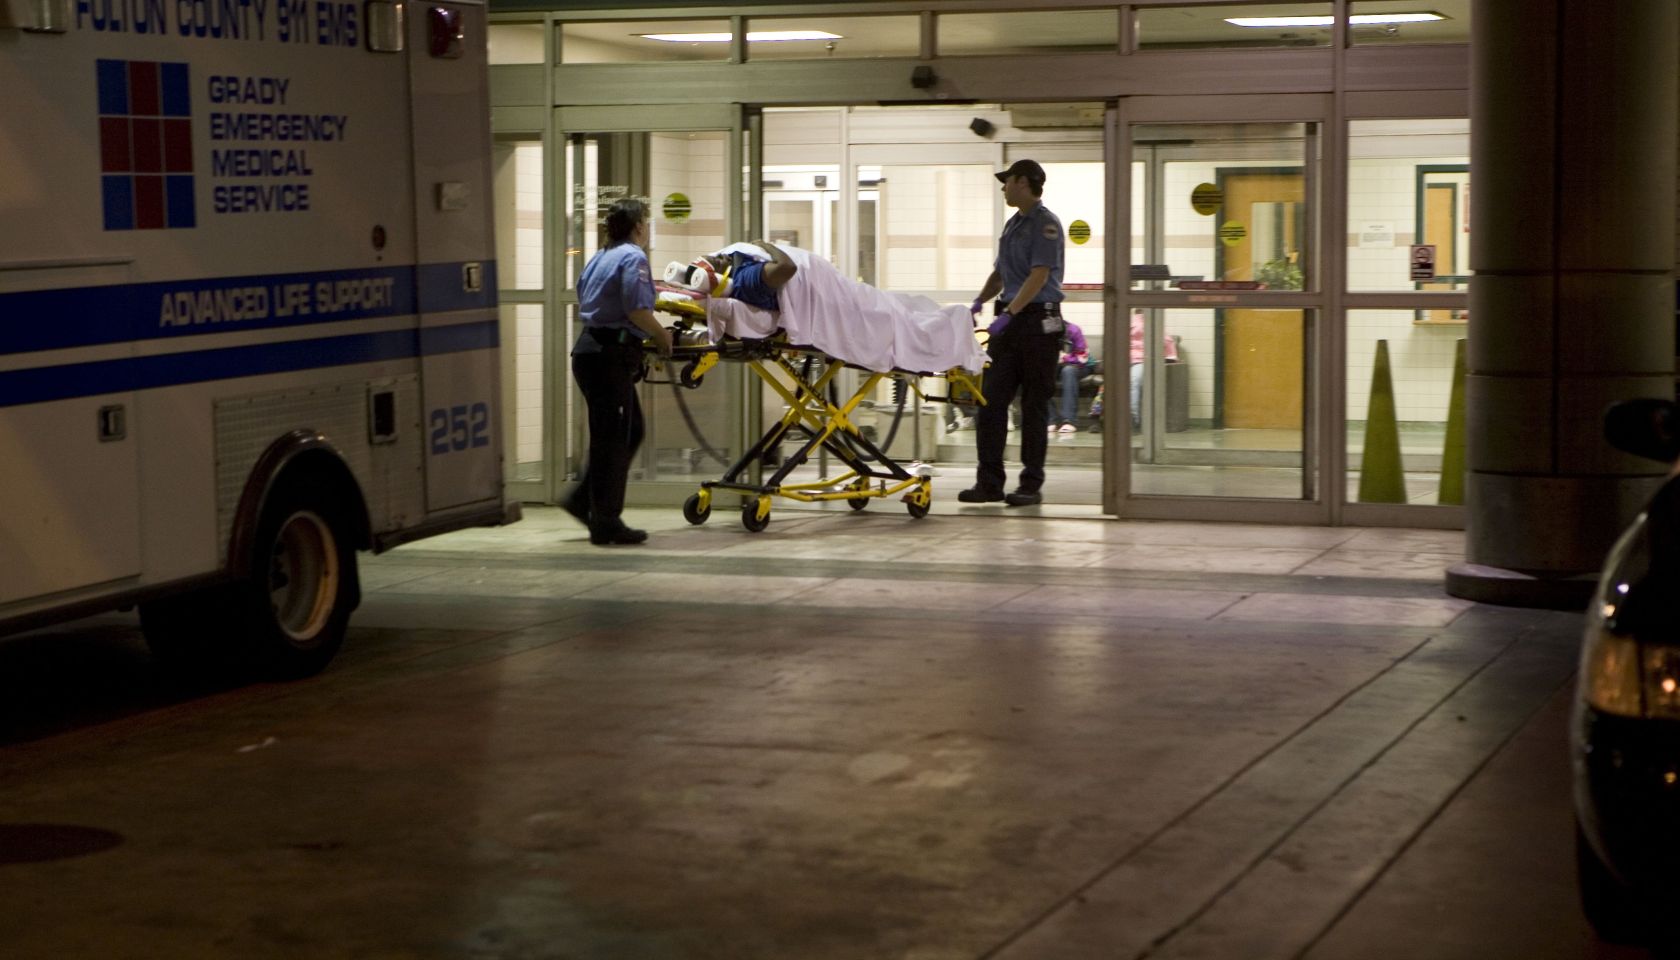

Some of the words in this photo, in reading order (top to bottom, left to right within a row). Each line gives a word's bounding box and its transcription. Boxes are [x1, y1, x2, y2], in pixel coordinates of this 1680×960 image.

[178, 0, 267, 41] COUNTY
[277, 0, 310, 44] 911
[317, 1, 358, 47] EMS
[208, 75, 290, 105] GRADY
[209, 112, 348, 142] EMERGENCY
[211, 149, 314, 177] MEDICAL
[213, 184, 311, 213] SERVICE
[574, 183, 629, 196] Emrgency
[159, 286, 270, 328] ADVANCED
[273, 283, 311, 317] LIFE
[315, 276, 395, 314] SUPPORT
[430, 402, 489, 456] 252
